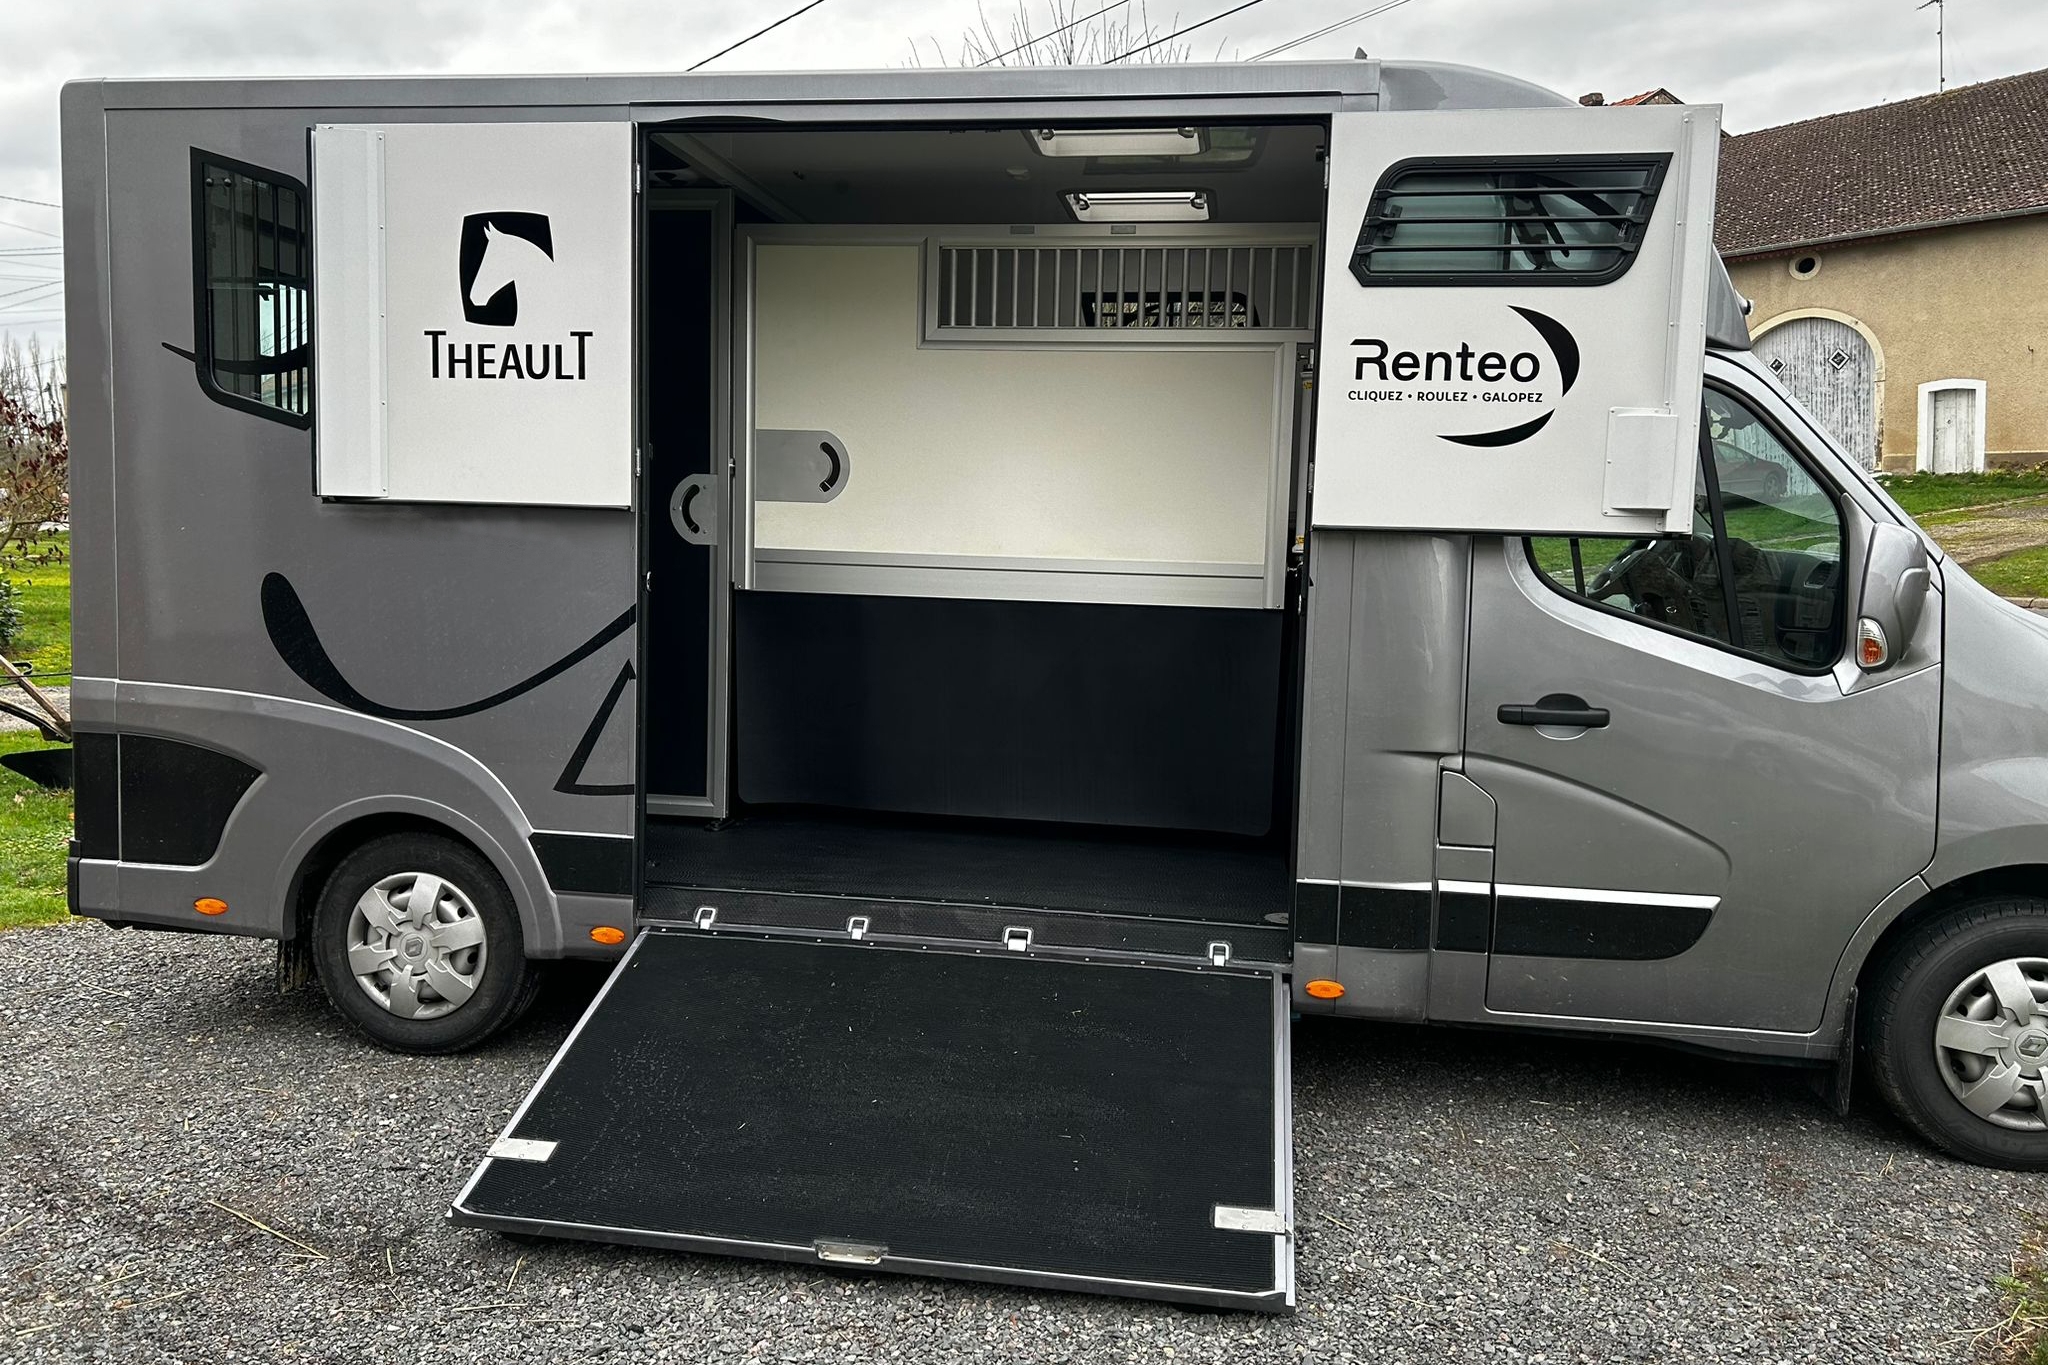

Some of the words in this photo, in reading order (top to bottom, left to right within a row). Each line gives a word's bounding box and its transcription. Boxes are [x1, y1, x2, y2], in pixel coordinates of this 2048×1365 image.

[424, 330, 594, 380] THEAULT
[1350, 338, 1541, 382] Renteo
[1348, 390, 1403, 403] CLIQUEZ
[1417, 391, 1468, 402] ROULEZ
[1482, 391, 1543, 403] GALOPEZ
